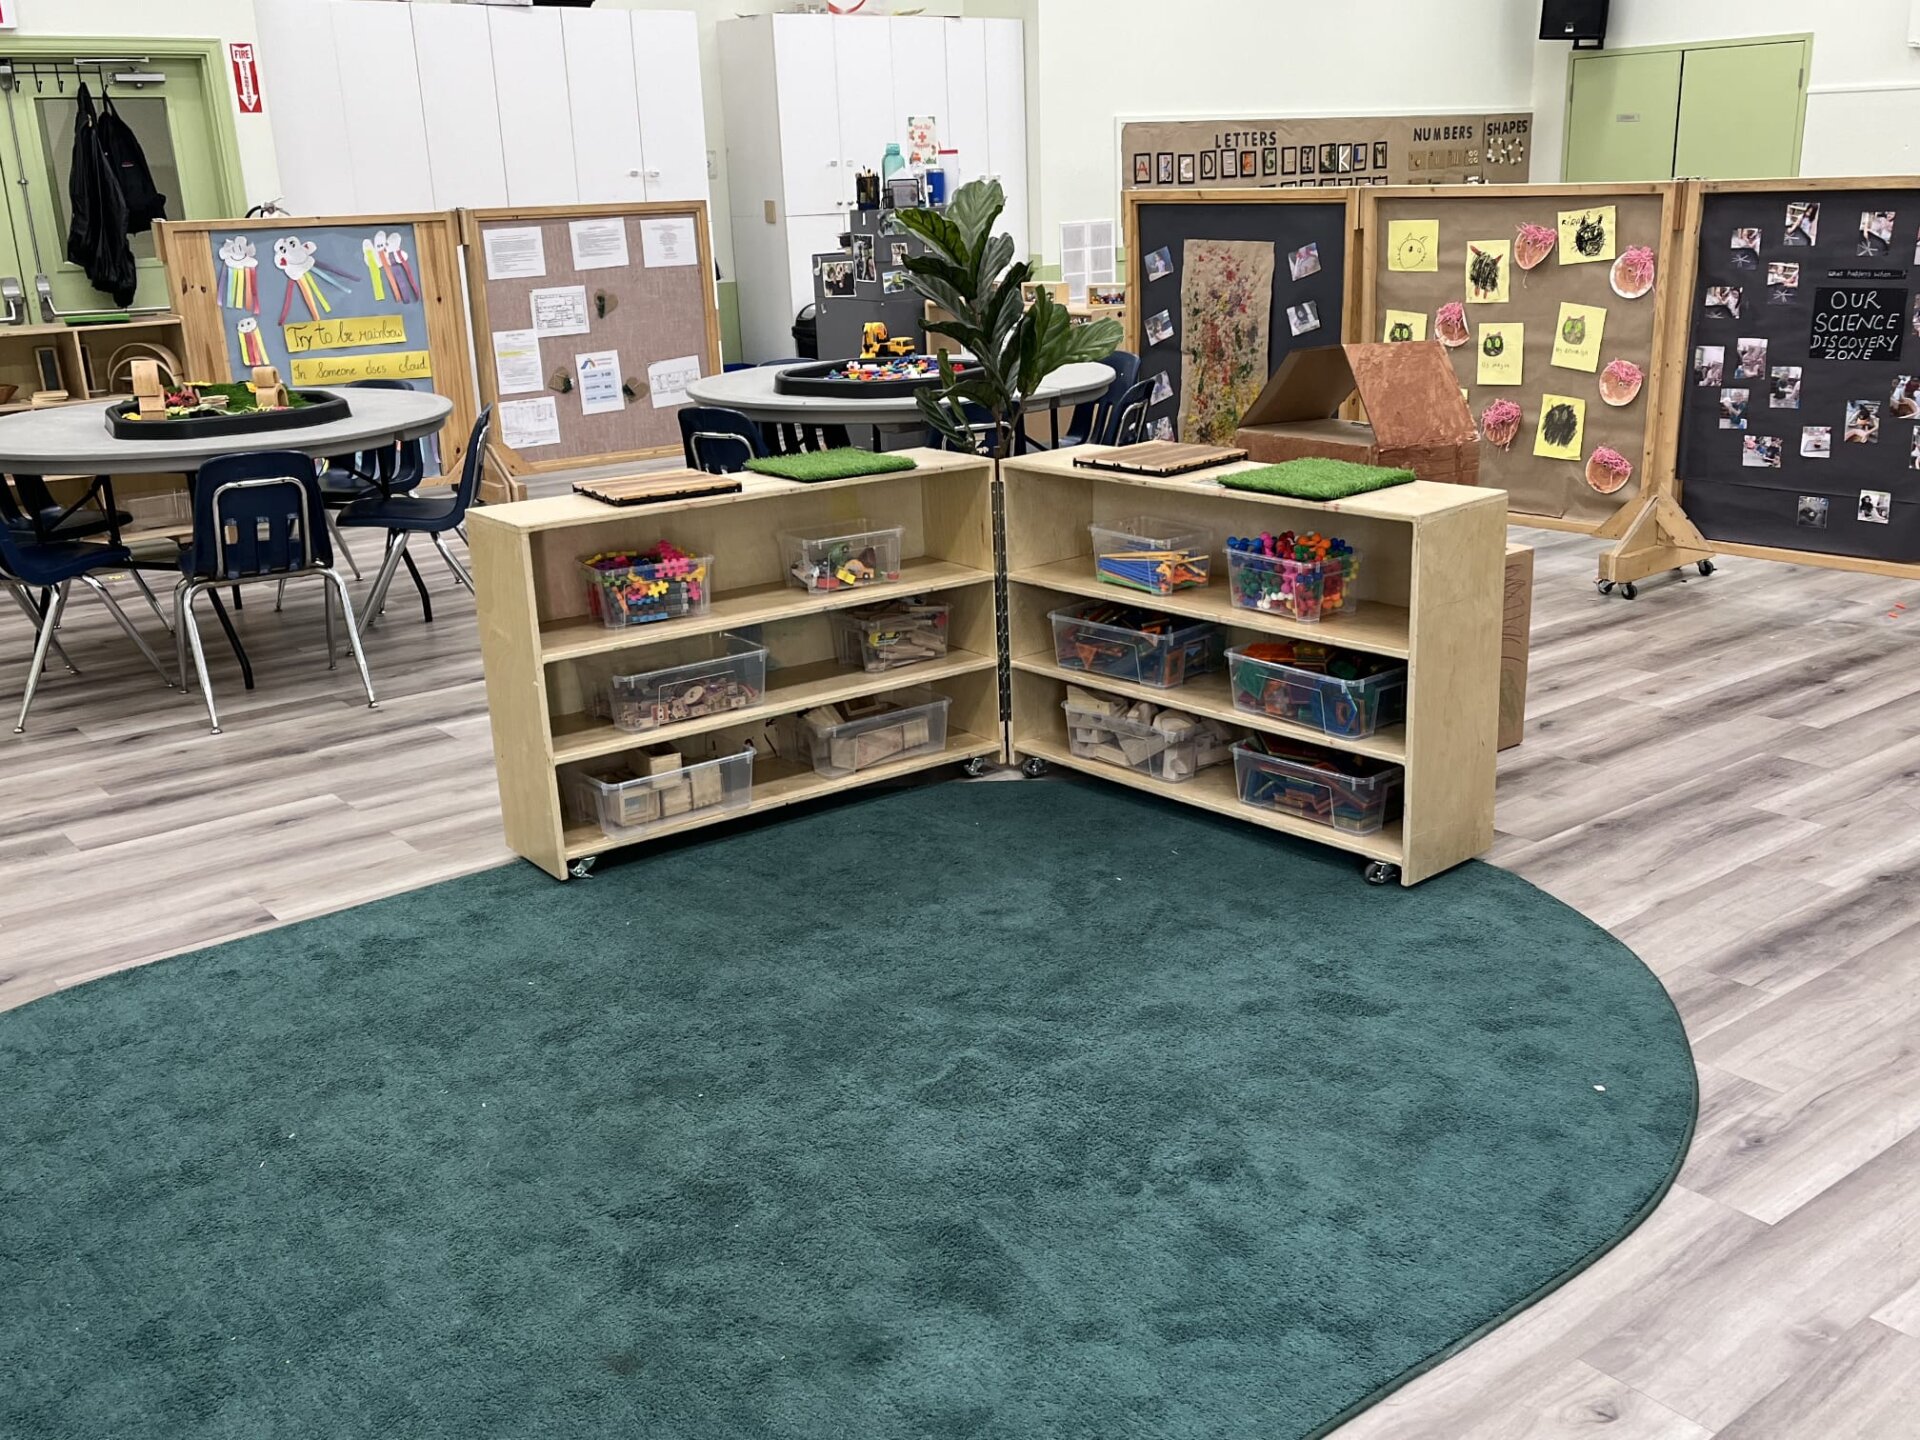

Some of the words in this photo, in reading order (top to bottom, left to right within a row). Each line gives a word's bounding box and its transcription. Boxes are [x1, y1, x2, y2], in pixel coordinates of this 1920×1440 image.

[234, 50, 250, 59] FIRE
[1413, 126, 1473, 141] NUMBERS
[1487, 120, 1529, 136] SHAPES
[1215, 131, 1277, 149] LETTERS
[1136, 161, 1149, 177] A
[1180, 158, 1193, 179] C
[1203, 154, 1213, 175] D
[1265, 150, 1274, 169] G
[1338, 145, 1350, 172] K
[1355, 147, 1364, 163] L
[1831, 290, 1881, 310] OUR
[1814, 312, 1900, 332] SCIENCE
[287, 325, 313, 351] Try
[314, 323, 333, 344] to
[336, 321, 354, 343] be
[359, 319, 403, 342] rainbow
[1810, 335, 1899, 352] DISCOVERY
[1824, 349, 1873, 360] ZONE
[293, 364, 307, 380] In
[398, 355, 428, 373] cloud
